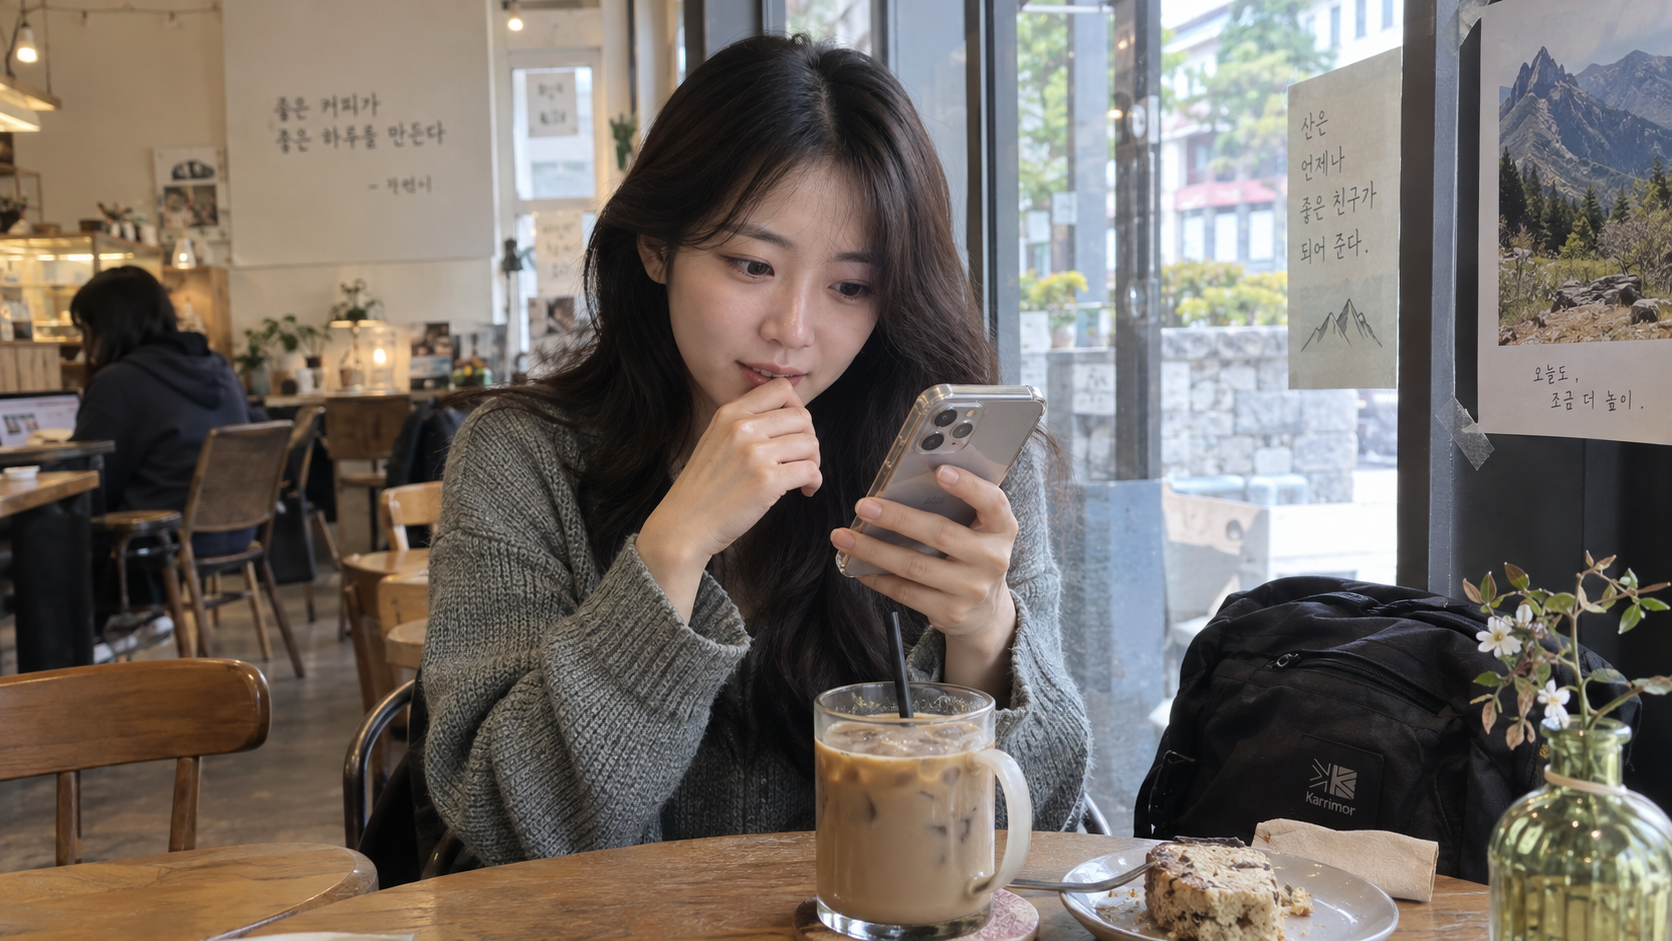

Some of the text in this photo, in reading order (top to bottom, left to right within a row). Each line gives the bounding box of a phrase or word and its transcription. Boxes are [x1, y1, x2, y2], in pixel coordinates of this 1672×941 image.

[274, 91, 381, 122] 좋은 커피가
[275, 120, 447, 154] 좋은 하루를 만든다
[1301, 110, 1328, 140] 산은
[1301, 146, 1345, 182] 언제나
[1300, 180, 1377, 225] 좋은 친구가
[1300, 228, 1369, 265] 되어 준다.
[1533, 364, 1579, 384] 오늘도,
[1551, 390, 1644, 411] 조금 더 높이.
[1305, 791, 1356, 816] Karrimor
